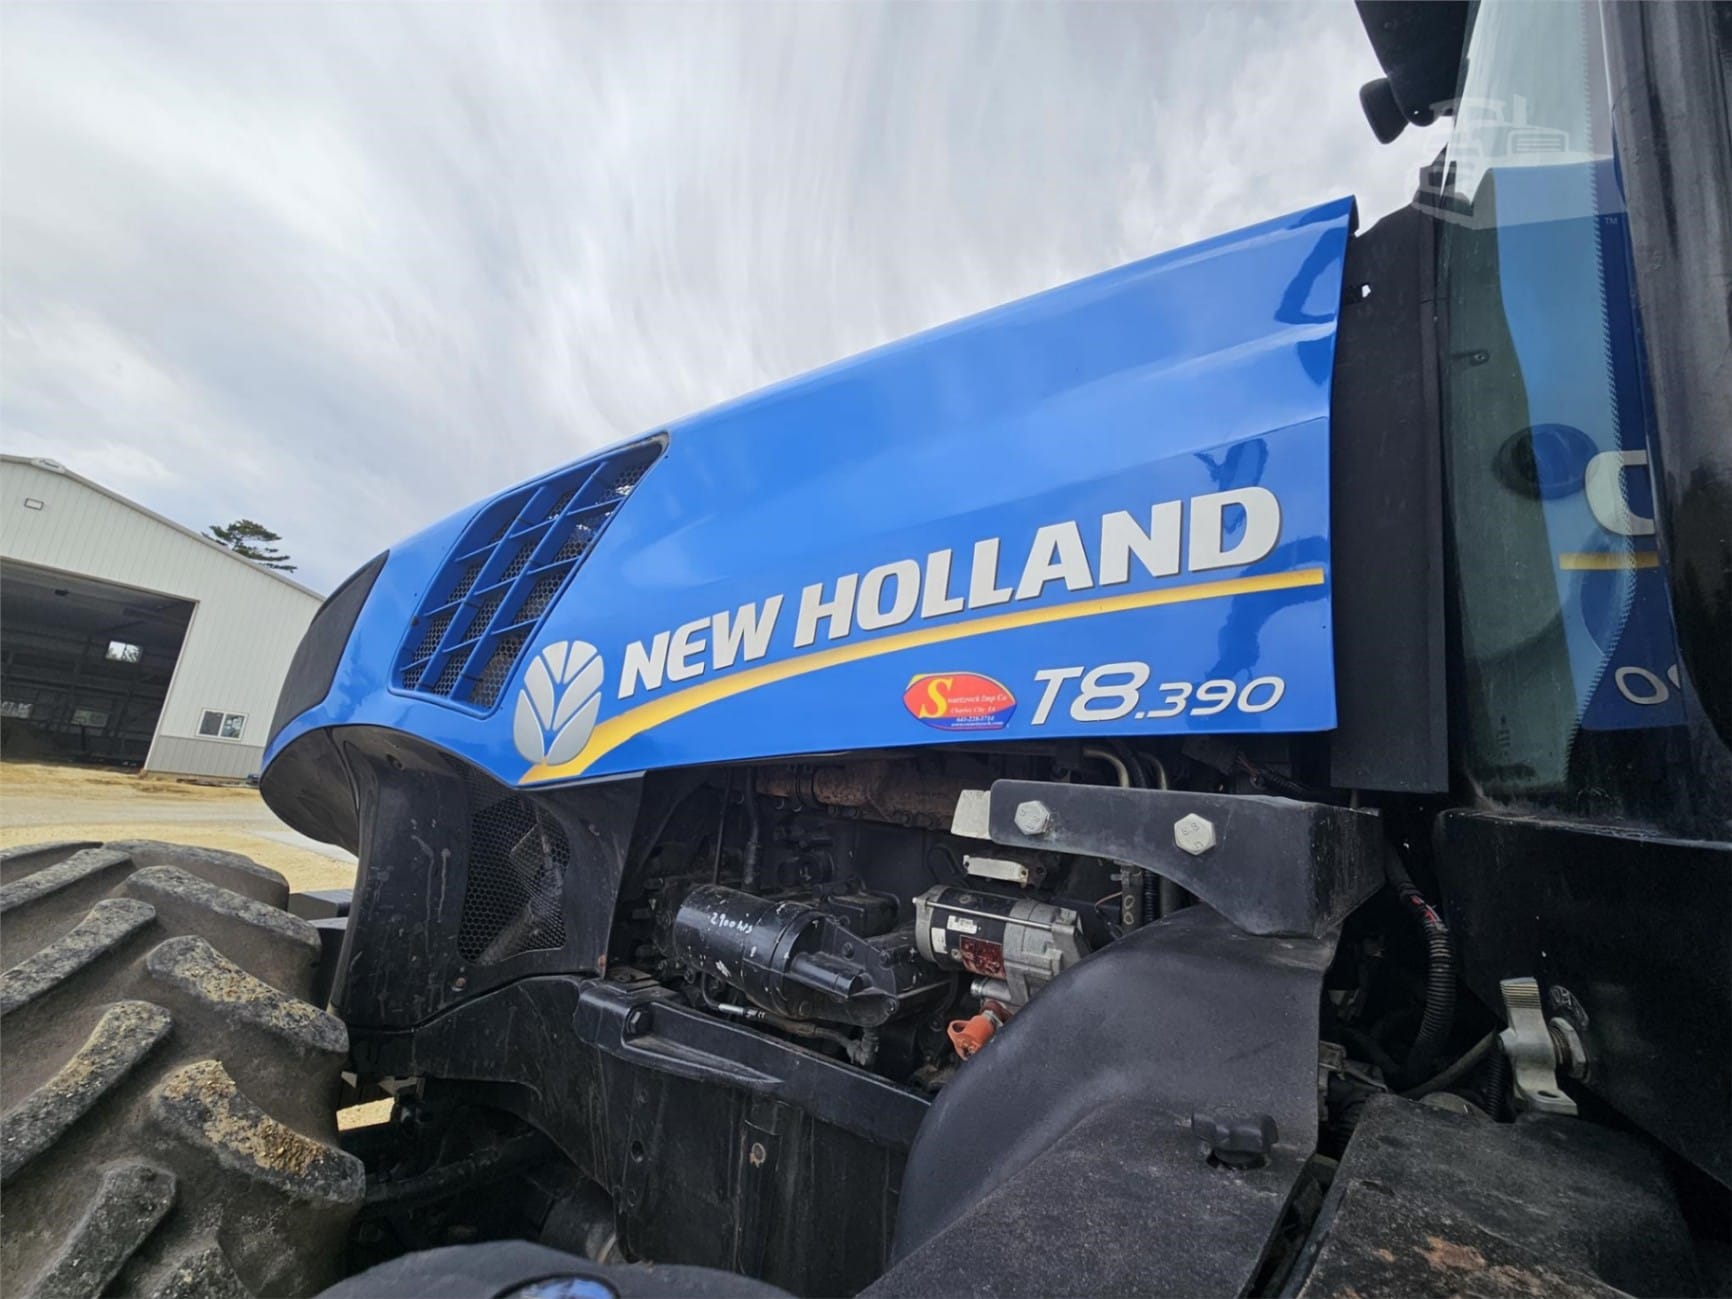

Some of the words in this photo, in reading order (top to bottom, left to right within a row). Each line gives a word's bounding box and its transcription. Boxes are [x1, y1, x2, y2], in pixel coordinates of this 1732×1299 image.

[617, 593, 785, 700] NEW
[793, 486, 1282, 649] HOLLAND
[1030, 660, 1286, 726] T8.390
